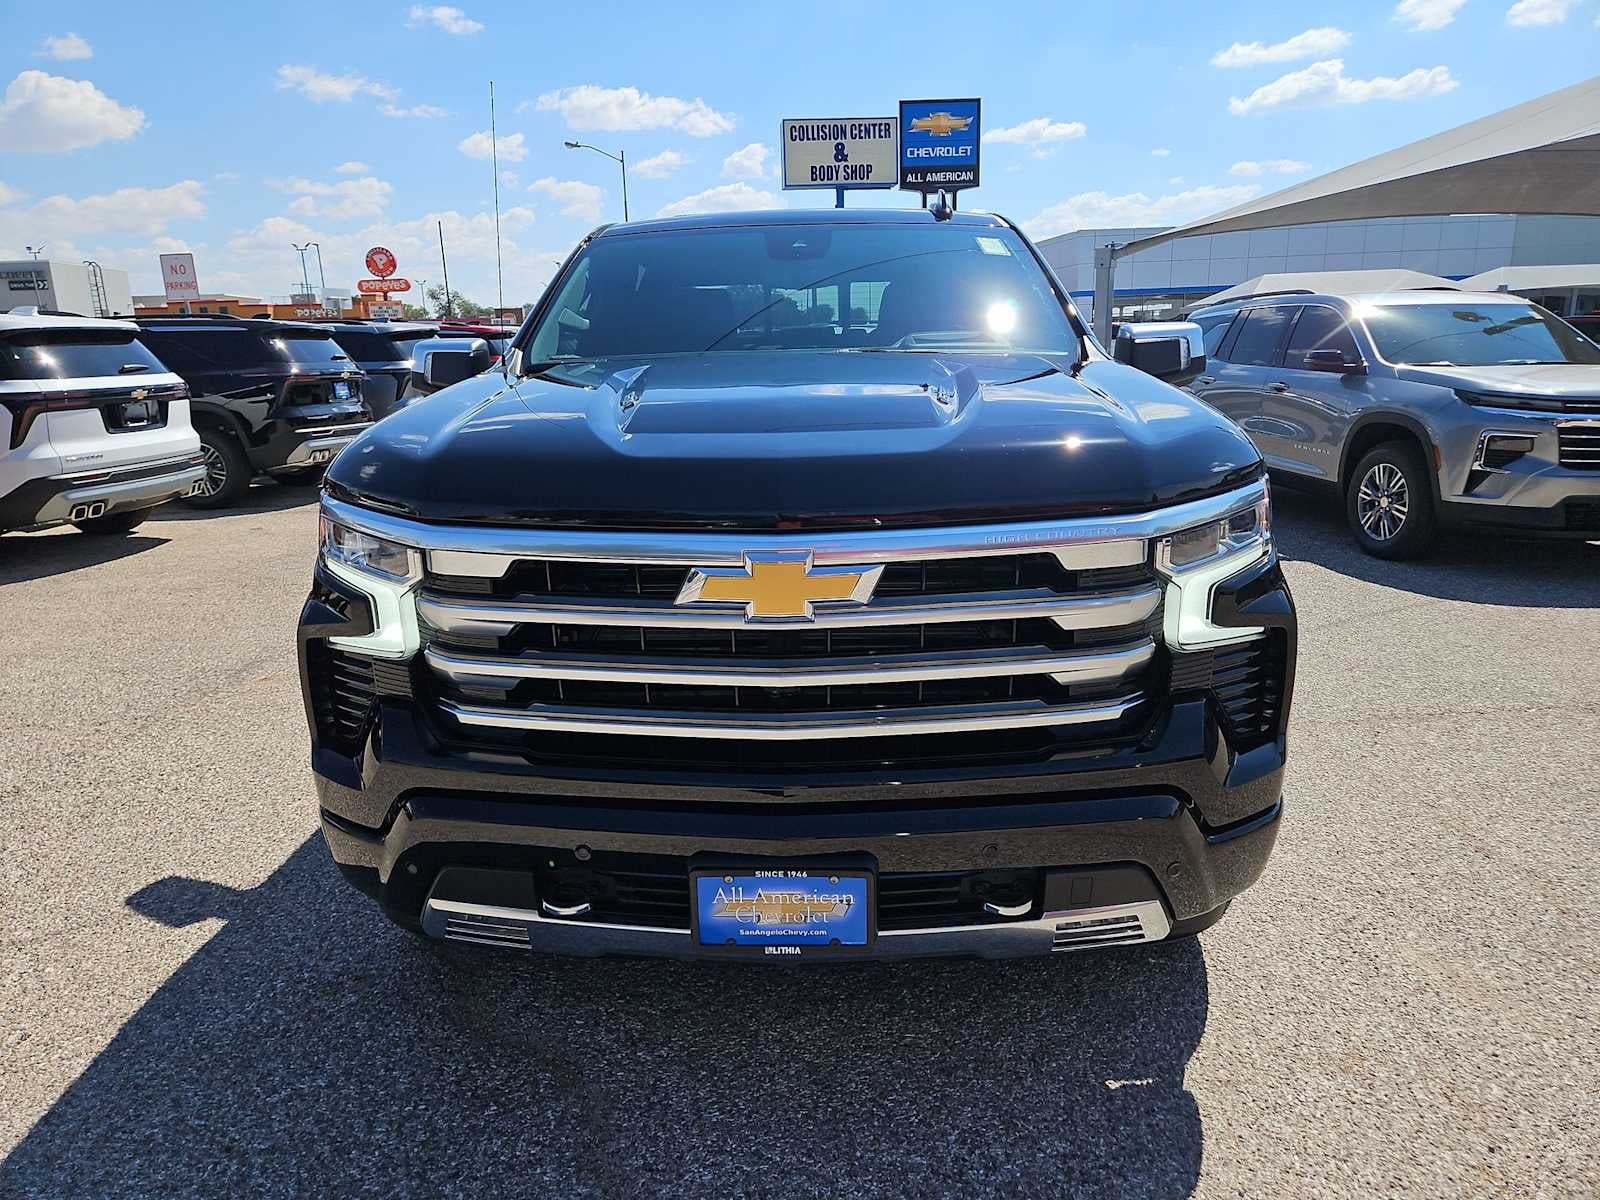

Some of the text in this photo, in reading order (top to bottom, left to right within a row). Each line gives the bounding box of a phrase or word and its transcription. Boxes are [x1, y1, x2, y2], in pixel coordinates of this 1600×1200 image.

[790, 122, 891, 142] COLLISION CENTER
[833, 142, 849, 163] &
[906, 145, 973, 158] CHEVROLET
[810, 164, 873, 182] BODY SHOP
[906, 171, 974, 183] ALL AMERICAN
[170, 264, 186, 275] NO
[166, 281, 198, 290] PARKING
[755, 870, 808, 879] SINCE 1946
[712, 886, 855, 905] All American
[735, 905, 830, 925] Chevrolet
[739, 928, 828, 937] SanAngeloChevy.com
